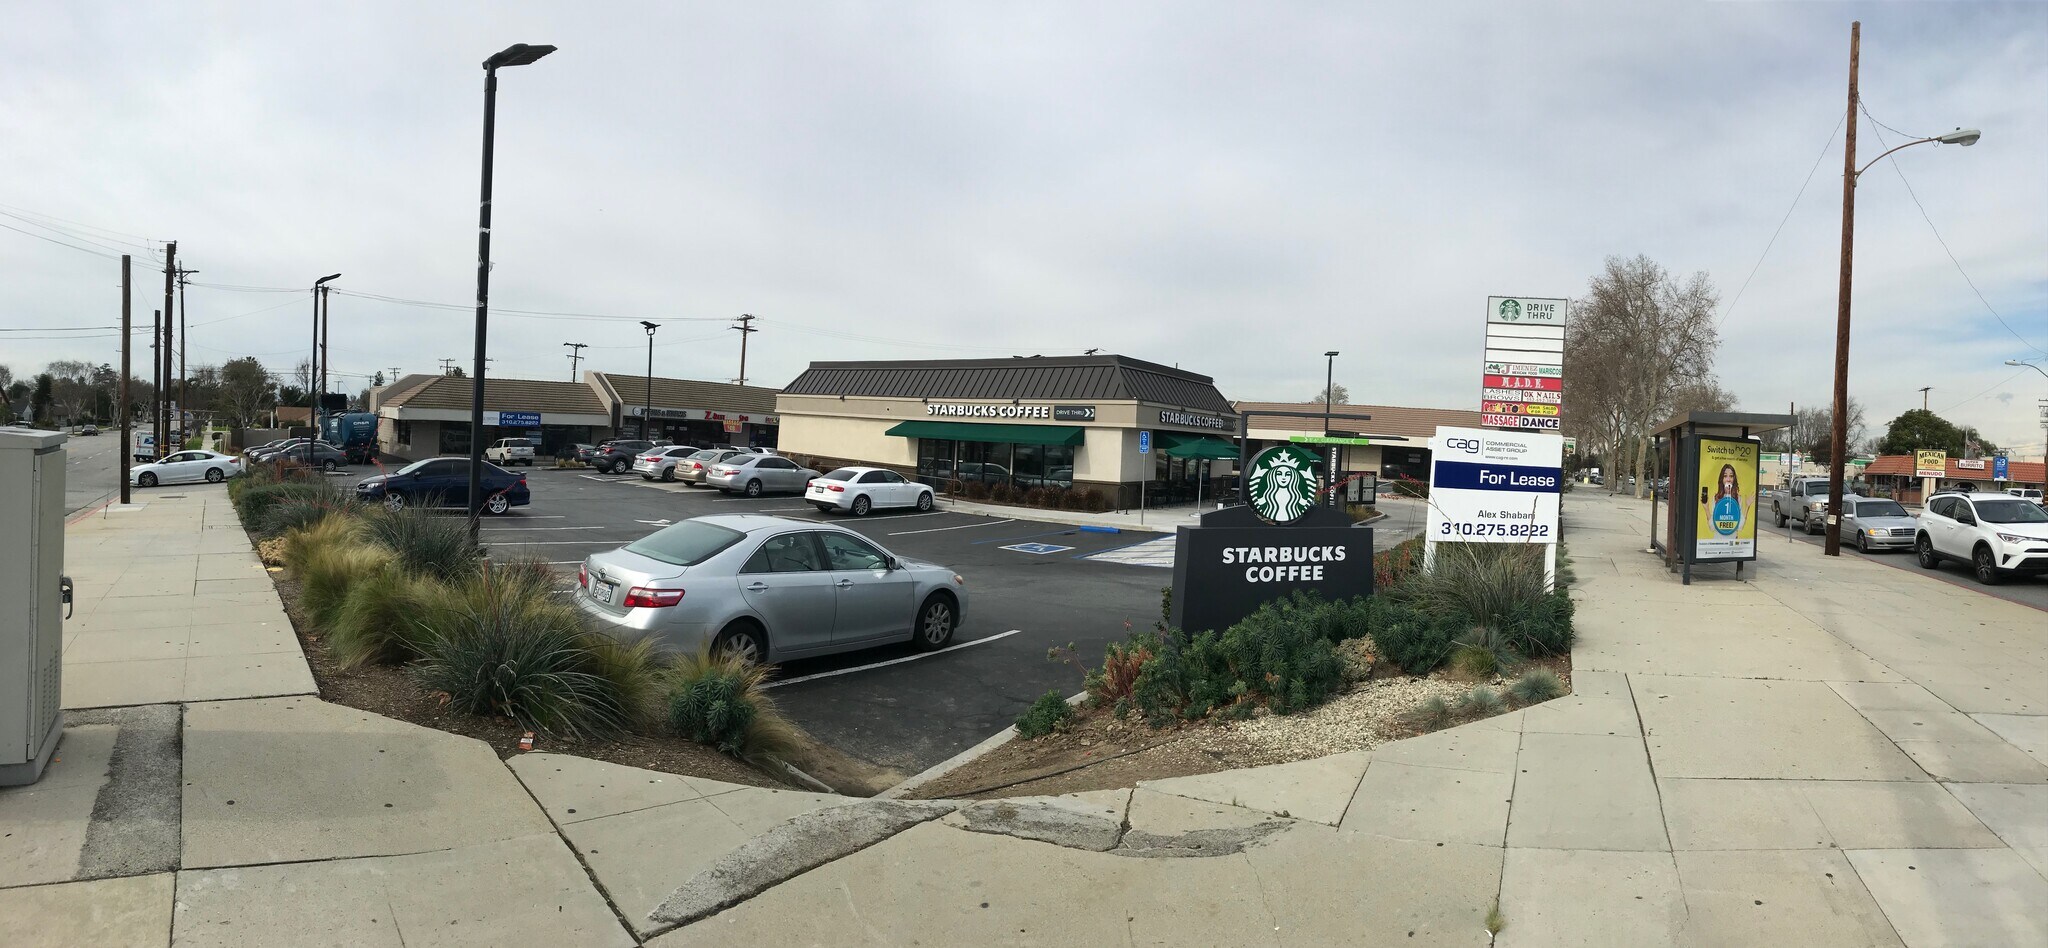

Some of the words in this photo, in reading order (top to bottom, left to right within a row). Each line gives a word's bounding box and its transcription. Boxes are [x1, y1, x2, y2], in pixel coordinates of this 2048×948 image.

[1527, 303, 1555, 312] DRIVE
[1527, 311, 1553, 320] THRU
[1539, 367, 1562, 376] MARISCOS
[1536, 391, 1561, 400] NAILS
[927, 404, 997, 417] STARBUCKS
[999, 405, 1049, 419] COFFEE
[1161, 411, 1201, 427] STARBUCKS
[1201, 416, 1223, 429] COFFEE
[1482, 414, 1519, 427] MASSAGE
[1521, 417, 1559, 429] DANCE
[1446, 437, 1480, 454] cag
[1485, 440, 1528, 449] COMMERCIAL
[1707, 445, 1728, 455] Switch
[1728, 447, 1735, 455] to
[1919, 451, 1944, 459] MEXICAN
[1479, 469, 1506, 485] For
[1510, 471, 1555, 487] Lease
[1725, 502, 1729, 514] 1
[1477, 509, 1497, 519] Alex
[1441, 522, 1549, 537] 310.275.8222
[1719, 521, 1734, 529] FREE!
[1222, 545, 1347, 564] STARBUCKS
[1245, 565, 1324, 583] COFFEE
